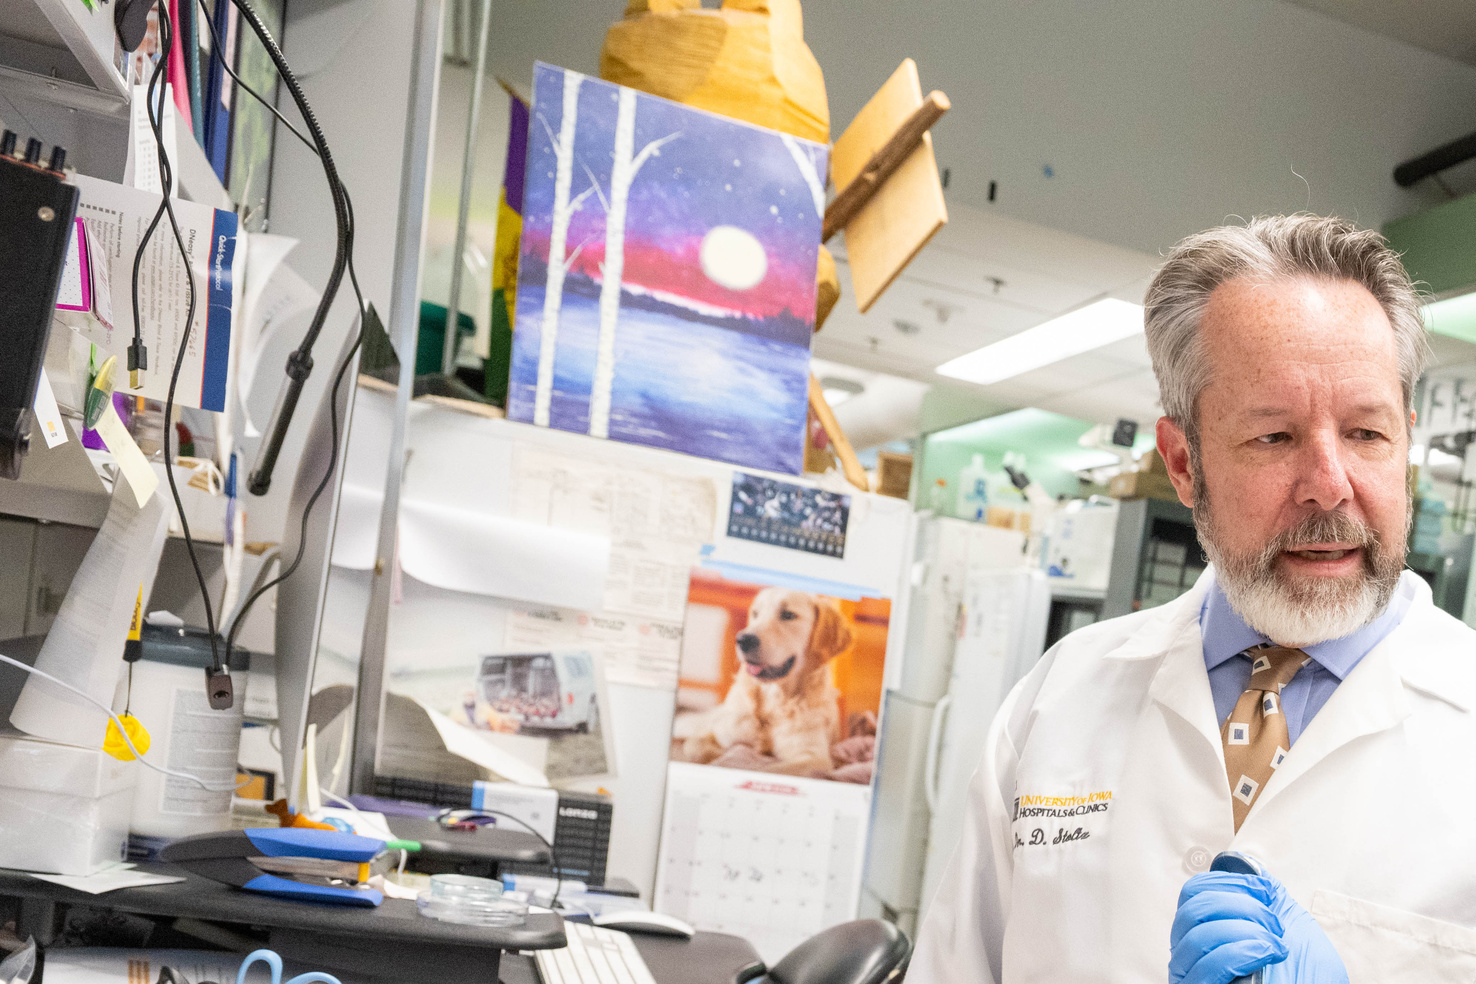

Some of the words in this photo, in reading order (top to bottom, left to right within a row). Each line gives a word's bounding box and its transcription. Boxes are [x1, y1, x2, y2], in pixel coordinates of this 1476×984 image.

[1020, 794, 1078, 807] UNIVERSITY
[1088, 790, 1112, 804] IOWA
[1019, 806, 1068, 818] HOSPITALS
[1075, 802, 1108, 816] CLINICS
[1028, 827, 1047, 846] D.
